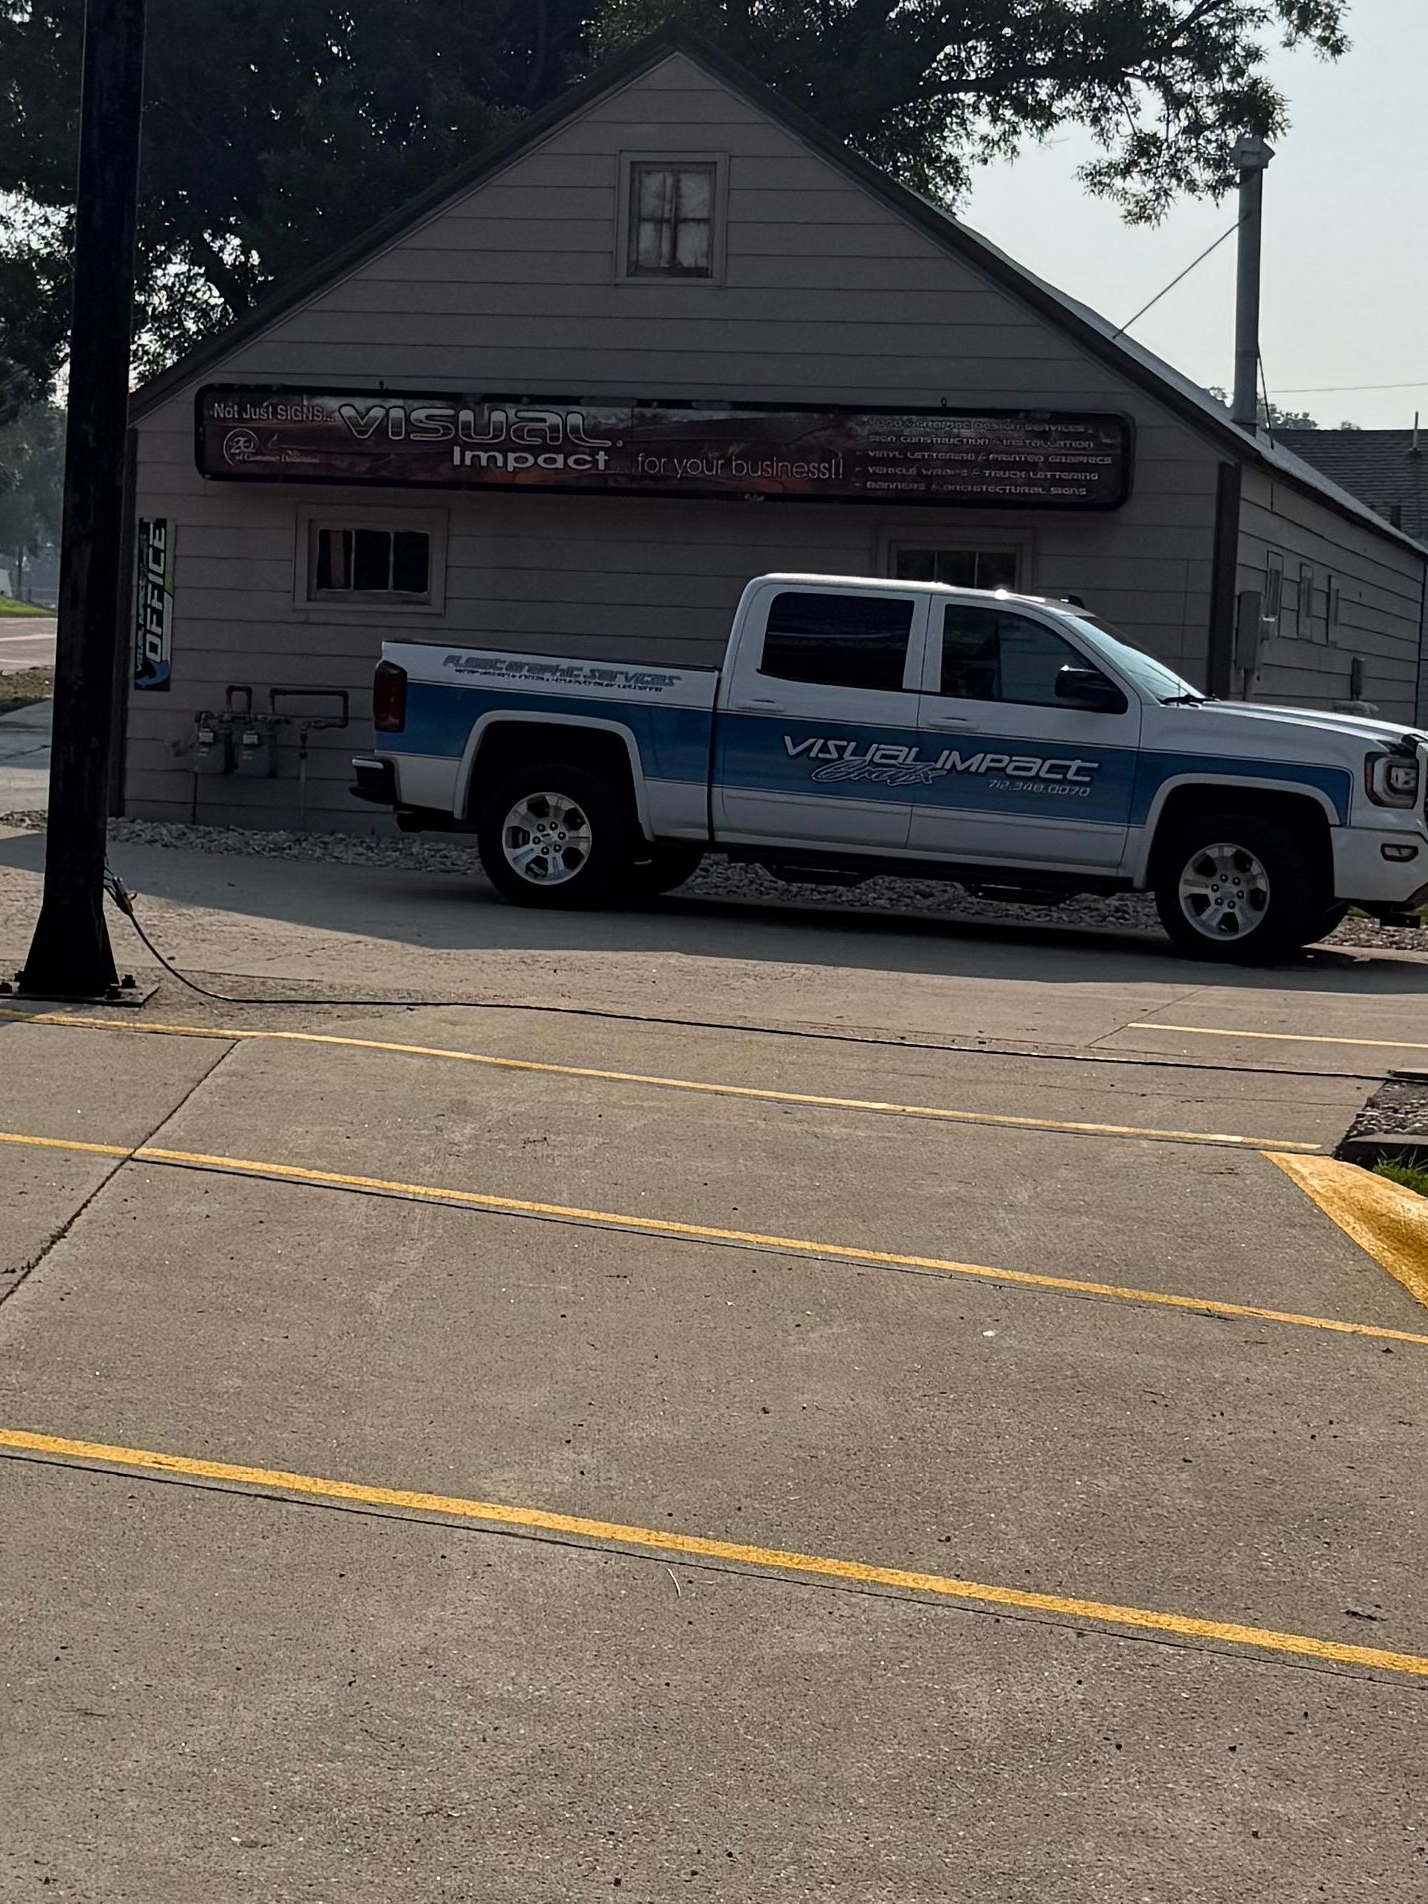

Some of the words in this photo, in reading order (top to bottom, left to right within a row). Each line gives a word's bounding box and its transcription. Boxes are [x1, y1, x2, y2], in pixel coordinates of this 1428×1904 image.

[213, 402, 239, 419] Not
[242, 403, 273, 421] Just
[1025, 424, 1085, 433] SERVICES
[900, 436, 989, 446] CONSTRUCTION
[453, 445, 609, 472] Impact
[868, 450, 904, 459] VINYL
[907, 452, 976, 461] LETTERING
[989, 453, 1044, 463] PRINTED
[1048, 455, 1113, 465] GRAPHICS
[637, 453, 667, 473] for
[674, 457, 724, 478] your
[732, 455, 844, 479] business!!
[868, 466, 917, 476] VEHICLE
[983, 470, 1026, 479] TRUCK
[1029, 471, 1099, 481] LETTERING
[867, 480, 926, 490] BANNERS
[943, 483, 1047, 494] ARCHITECTURAL
[1050, 486, 1087, 496] SIGNS
[145, 522, 166, 663] OFFICE
